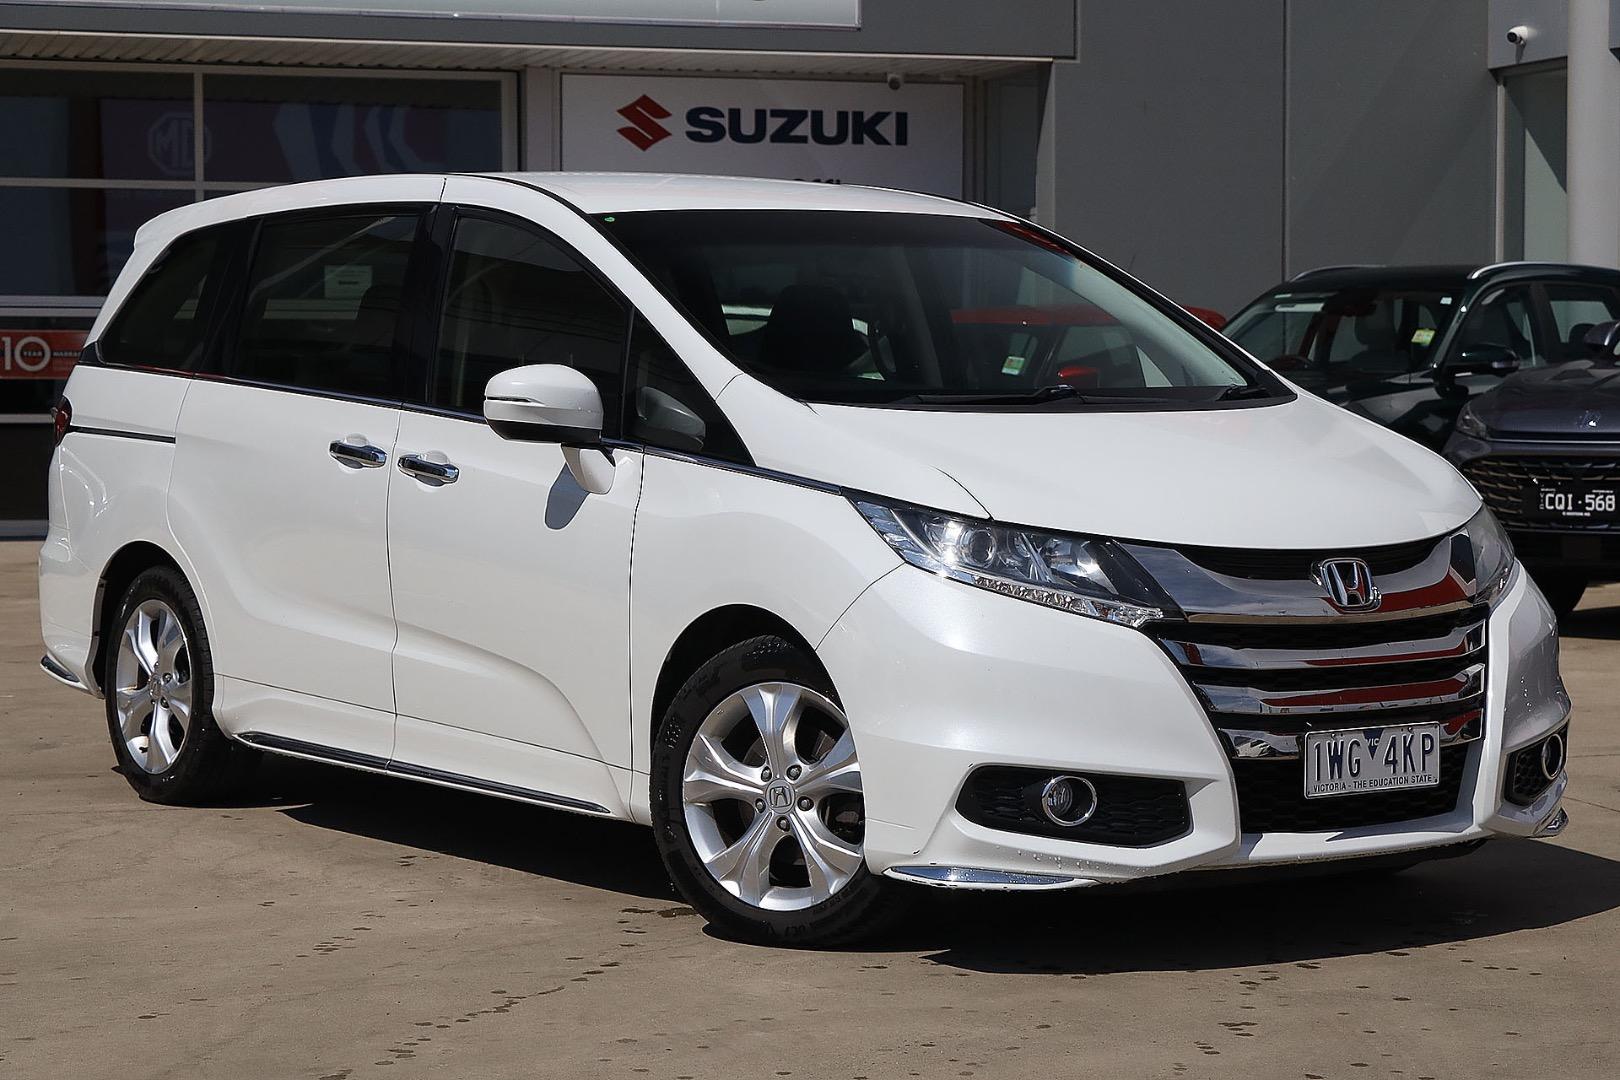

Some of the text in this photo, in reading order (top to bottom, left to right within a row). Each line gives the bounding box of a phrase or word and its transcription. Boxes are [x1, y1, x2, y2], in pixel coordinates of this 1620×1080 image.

[685, 106, 908, 146] SUZUKI
[1, 336, 52, 372] 10
[1314, 732, 1435, 781] 1WG 4KP
[1313, 782, 1347, 793] VICTORIA
[1353, 779, 1367, 788] THE
[1369, 775, 1409, 787] EDUCATION
[1411, 774, 1432, 783] STATE
